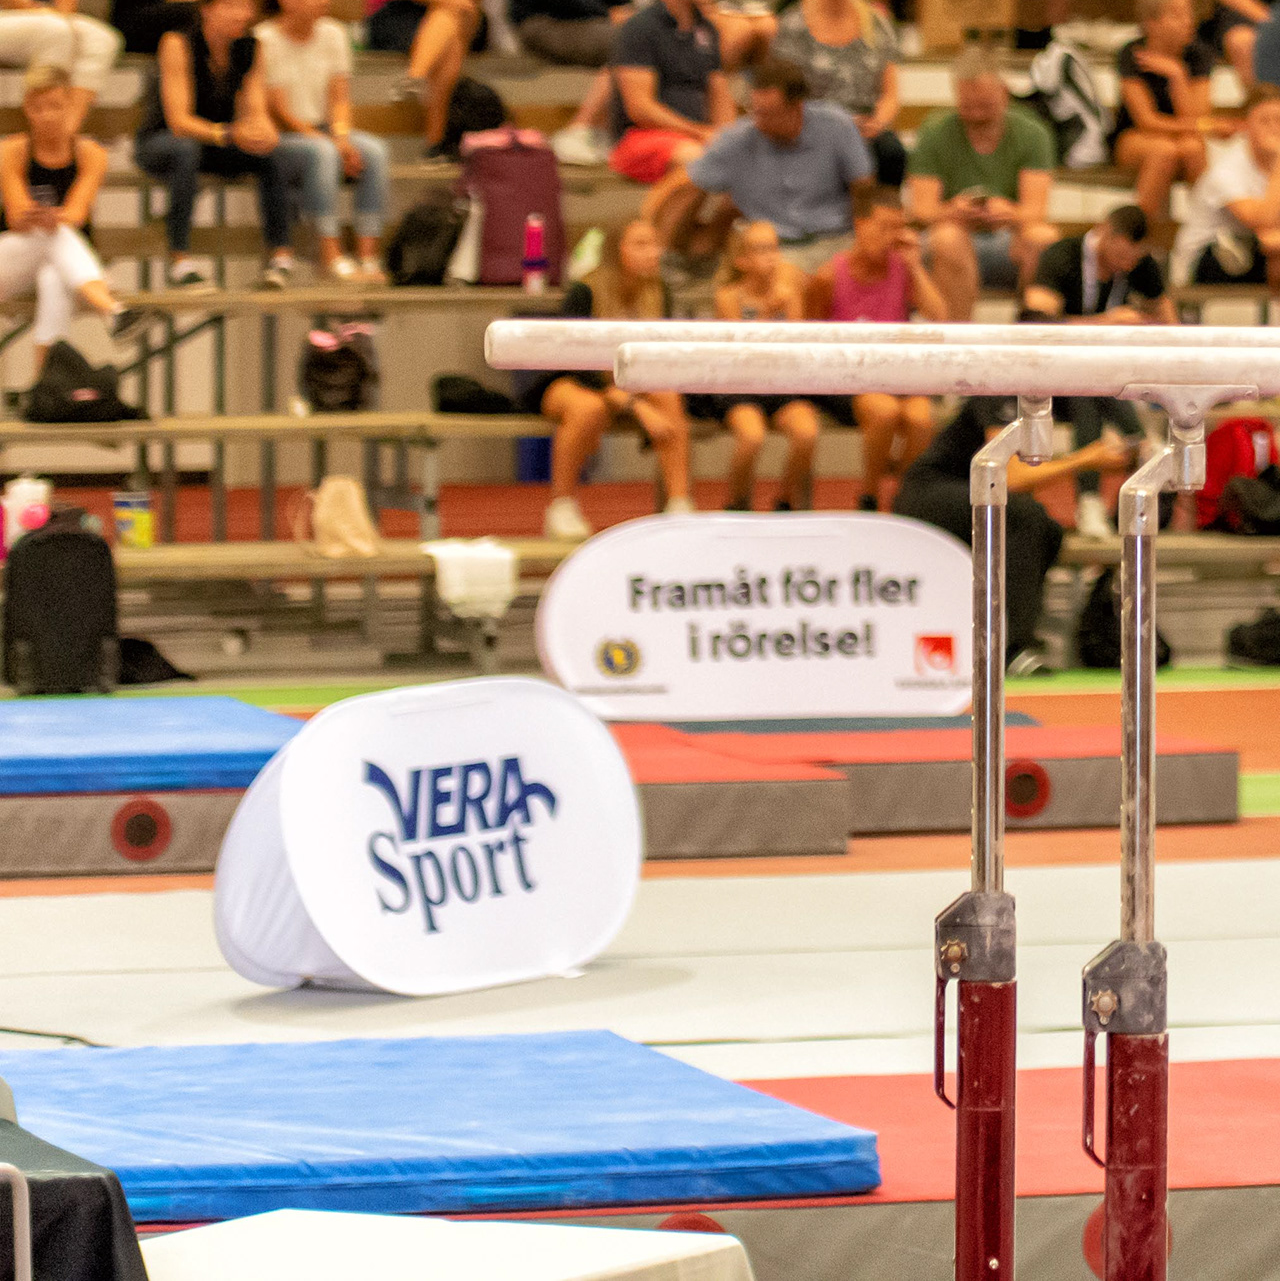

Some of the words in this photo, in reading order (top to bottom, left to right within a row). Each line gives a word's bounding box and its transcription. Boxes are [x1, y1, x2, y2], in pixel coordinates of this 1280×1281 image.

[627, 566, 769, 611] Framåt
[780, 568, 839, 606] för
[850, 566, 922, 606] fler
[688, 622, 701, 661] i
[710, 619, 877, 660] rörelse!
[363, 756, 557, 841] VERA
[367, 830, 536, 934] Sport
